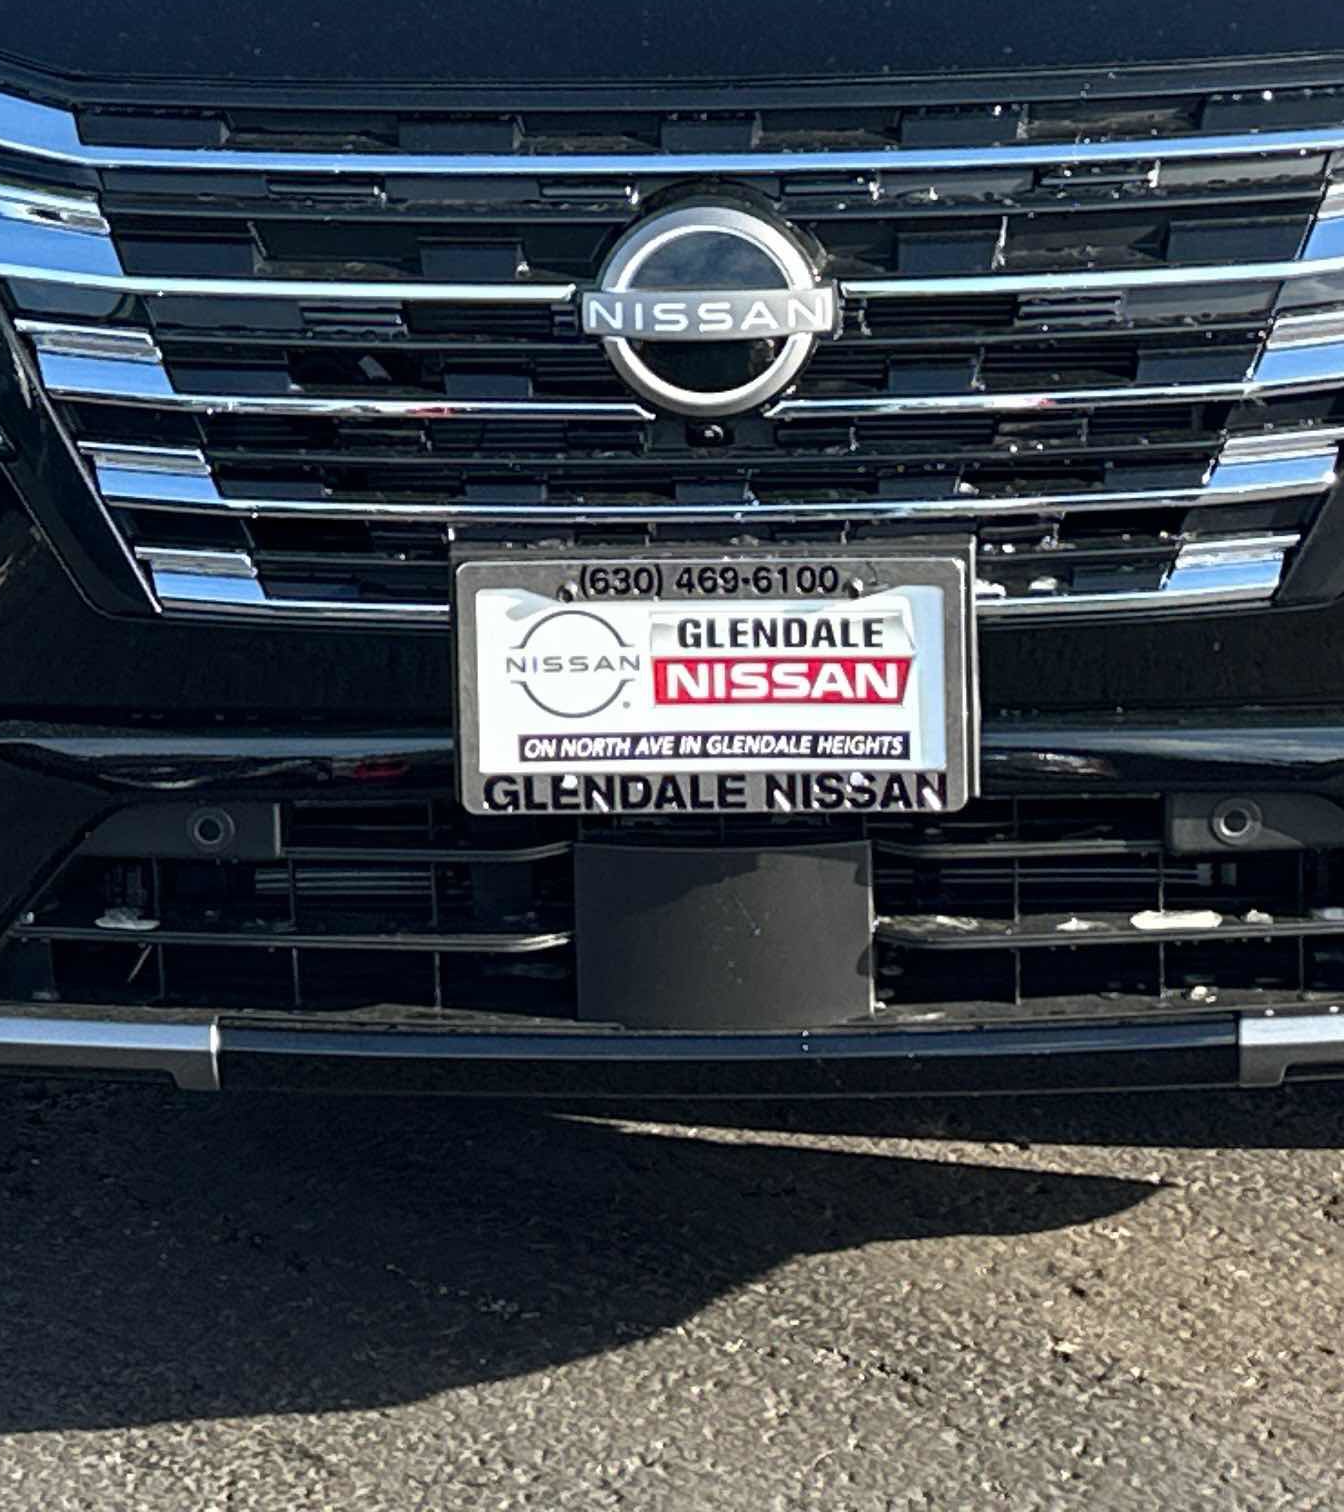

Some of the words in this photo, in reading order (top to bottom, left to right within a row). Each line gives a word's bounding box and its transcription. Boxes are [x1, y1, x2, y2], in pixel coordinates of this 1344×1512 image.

[587, 298, 824, 334] NISSAN
[579, 562, 664, 599] (630)
[675, 565, 840, 594] 469-6100
[676, 617, 885, 650] GLENDALE
[505, 654, 641, 674] NISSAN
[665, 662, 899, 700] NISSAN
[524, 738, 555, 759] ON
[559, 736, 631, 758] NORTH
[633, 736, 675, 756] AVE
[678, 735, 701, 755] IN
[706, 734, 812, 756] GLENDALE
[816, 734, 904, 755] HEIGHTS
[482, 774, 747, 812] GLENDALE
[764, 773, 948, 811] NISSAN
